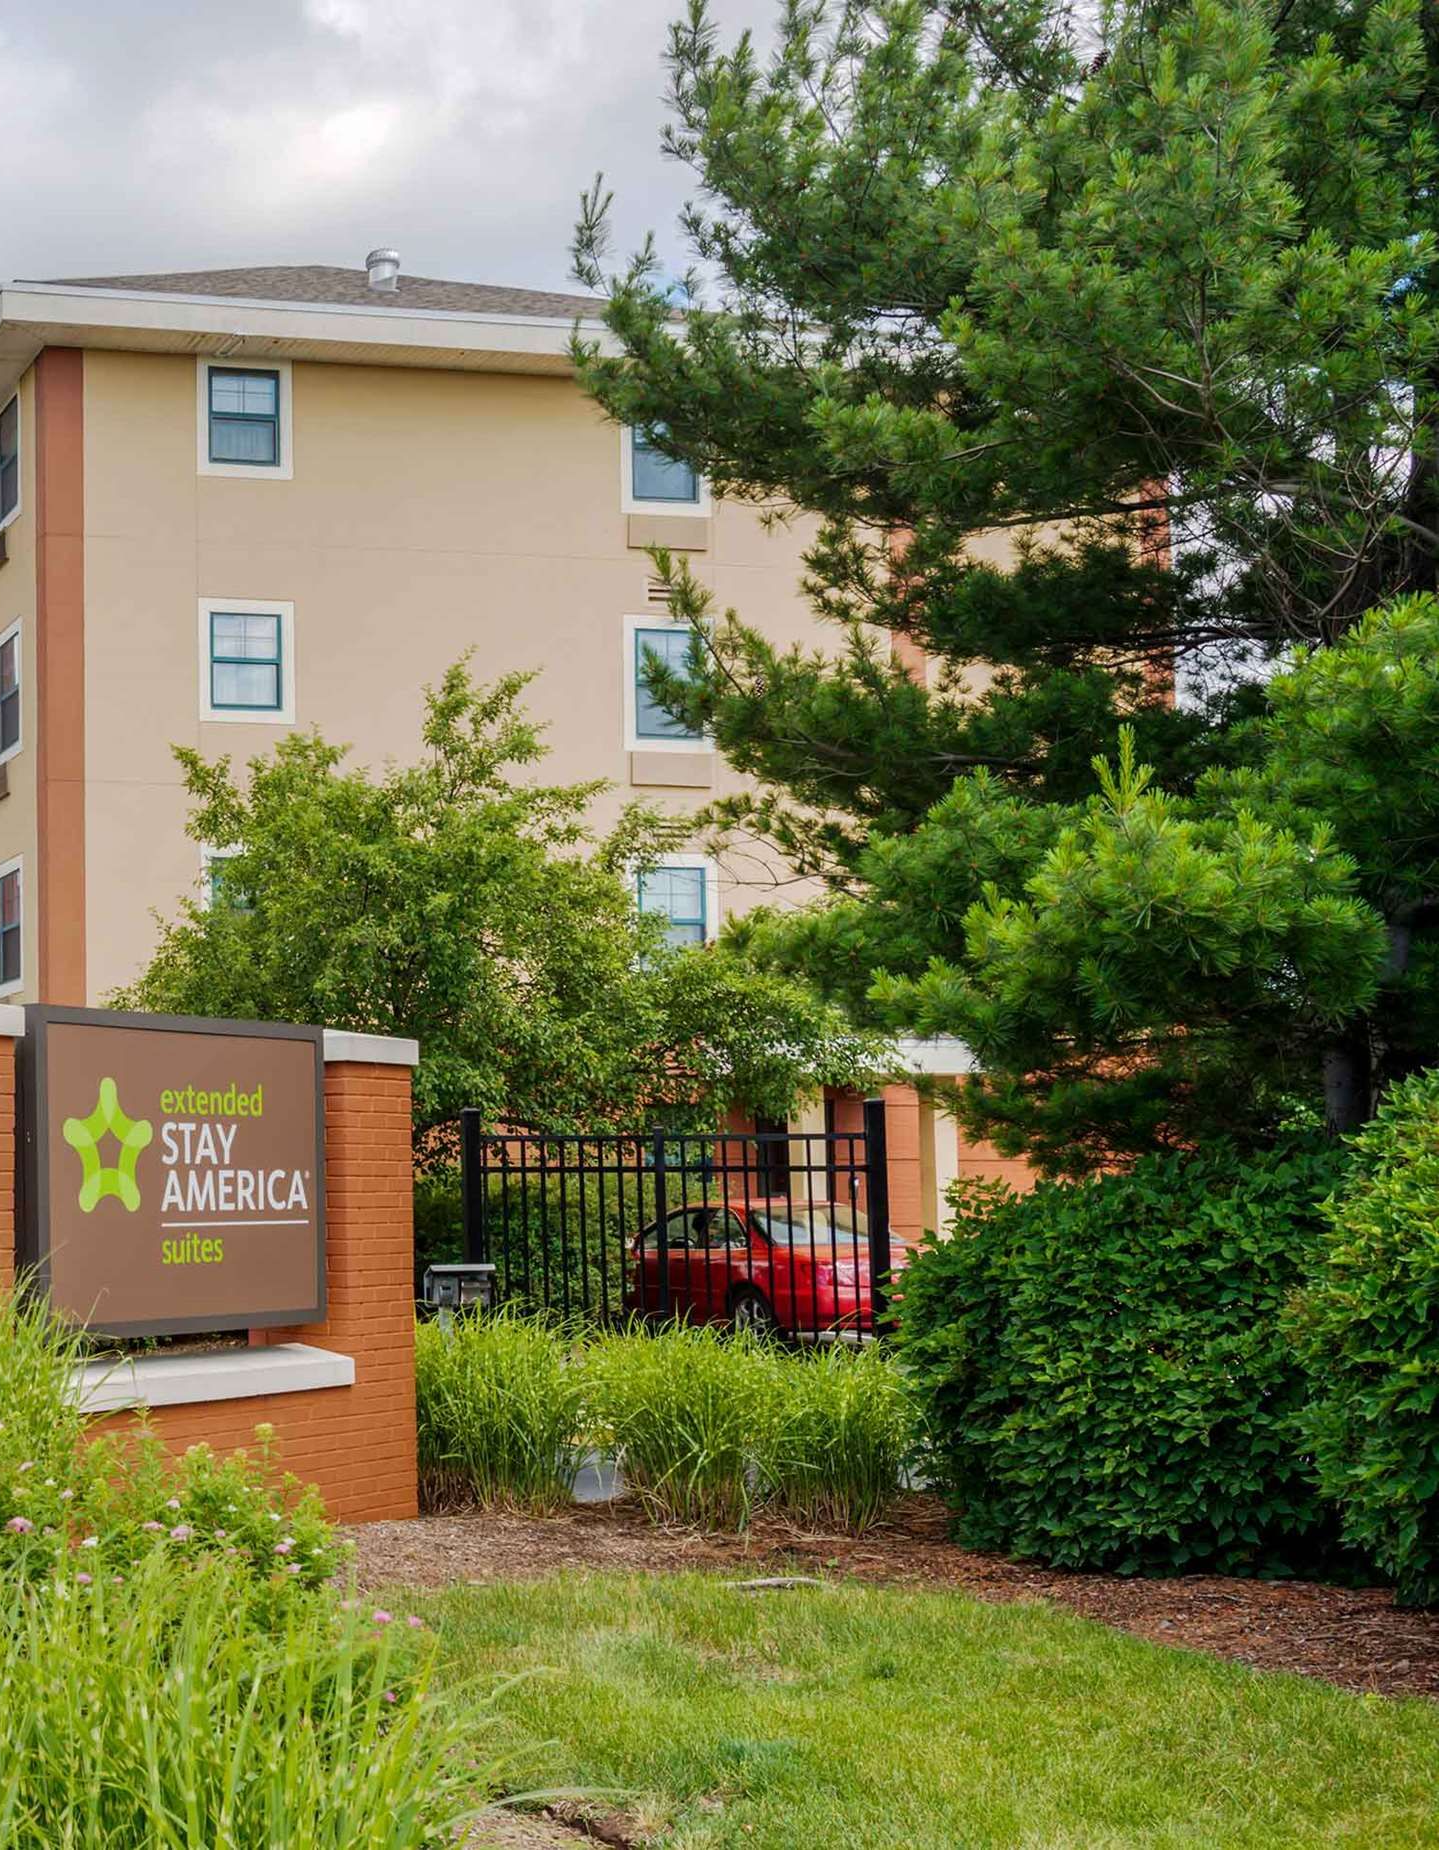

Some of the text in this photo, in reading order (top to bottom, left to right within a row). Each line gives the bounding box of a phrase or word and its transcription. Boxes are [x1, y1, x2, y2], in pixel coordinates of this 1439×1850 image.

[161, 1083, 262, 1117] extended
[162, 1122, 237, 1165] STAY
[161, 1169, 309, 1212] AMERICA
[162, 1233, 223, 1264] suites
